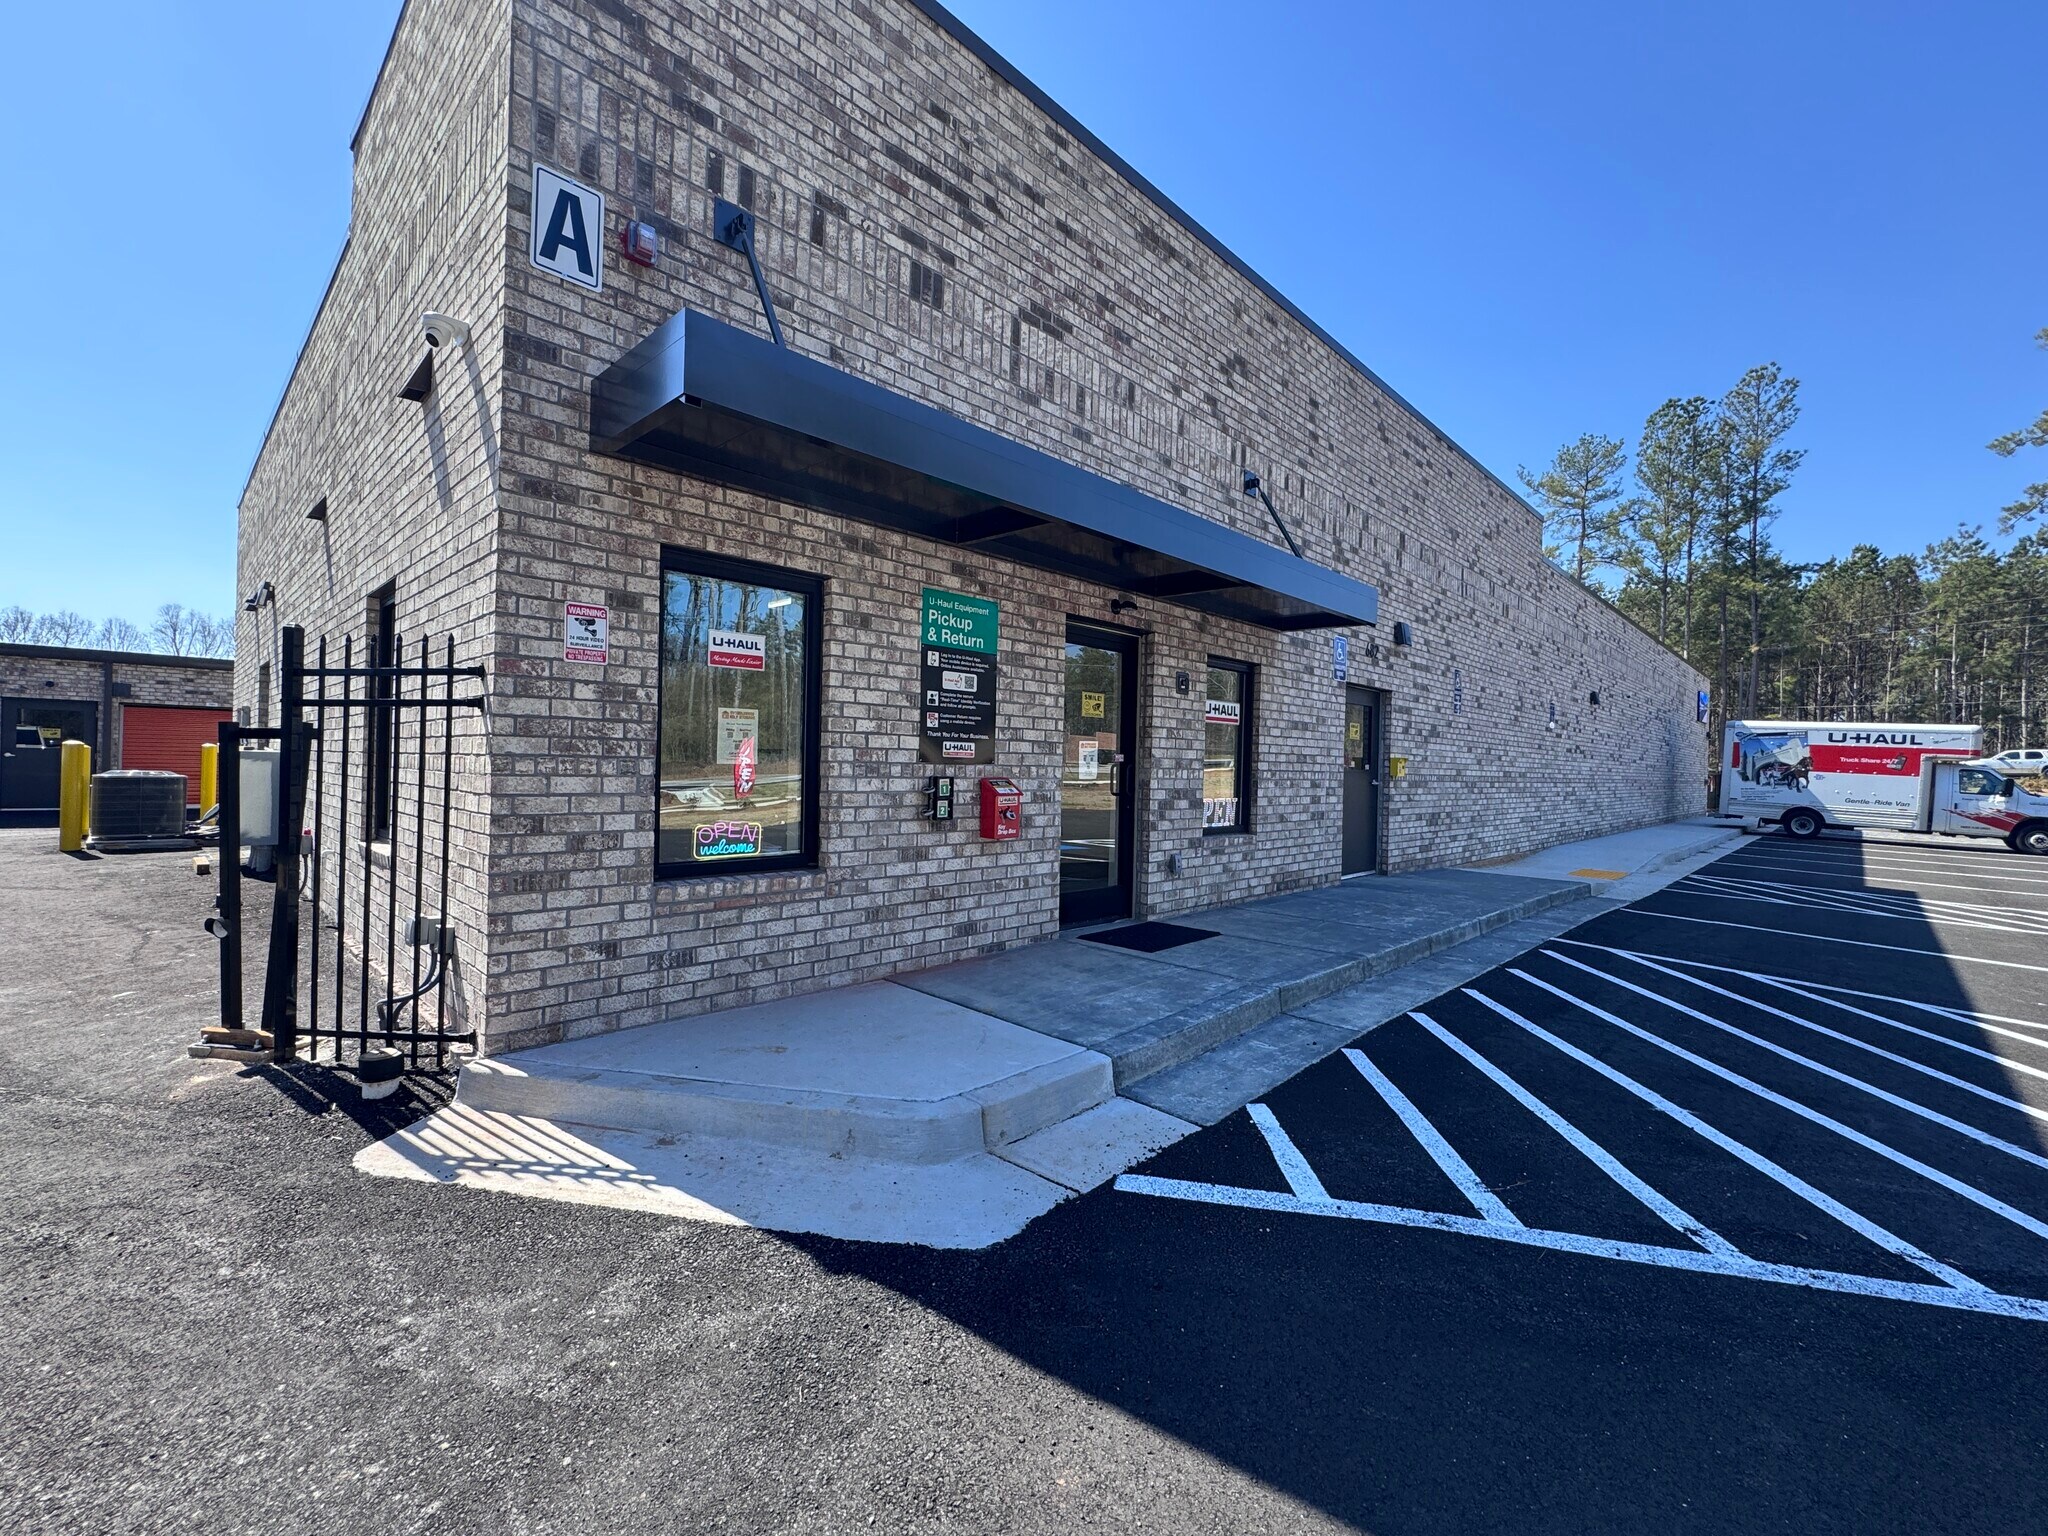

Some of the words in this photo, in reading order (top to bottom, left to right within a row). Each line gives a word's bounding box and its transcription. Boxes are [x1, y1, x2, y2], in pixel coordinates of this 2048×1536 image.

[539, 188, 594, 277] A
[568, 606, 606, 618] WARNING
[930, 596, 953, 608] U-Haul
[954, 602, 989, 616] Equipment
[928, 609, 972, 632] Pickup
[713, 637, 761, 650] U-HAUL
[928, 627, 937, 641] &
[942, 629, 984, 648] Return
[1366, 642, 1379, 659] 682
[1828, 732, 1923, 745] U-HAUL
[1845, 798, 1893, 806] Gentle-Ride
[1202, 798, 1238, 827] PEN
[698, 821, 757, 843] OPEN
[700, 839, 755, 855] welcome
